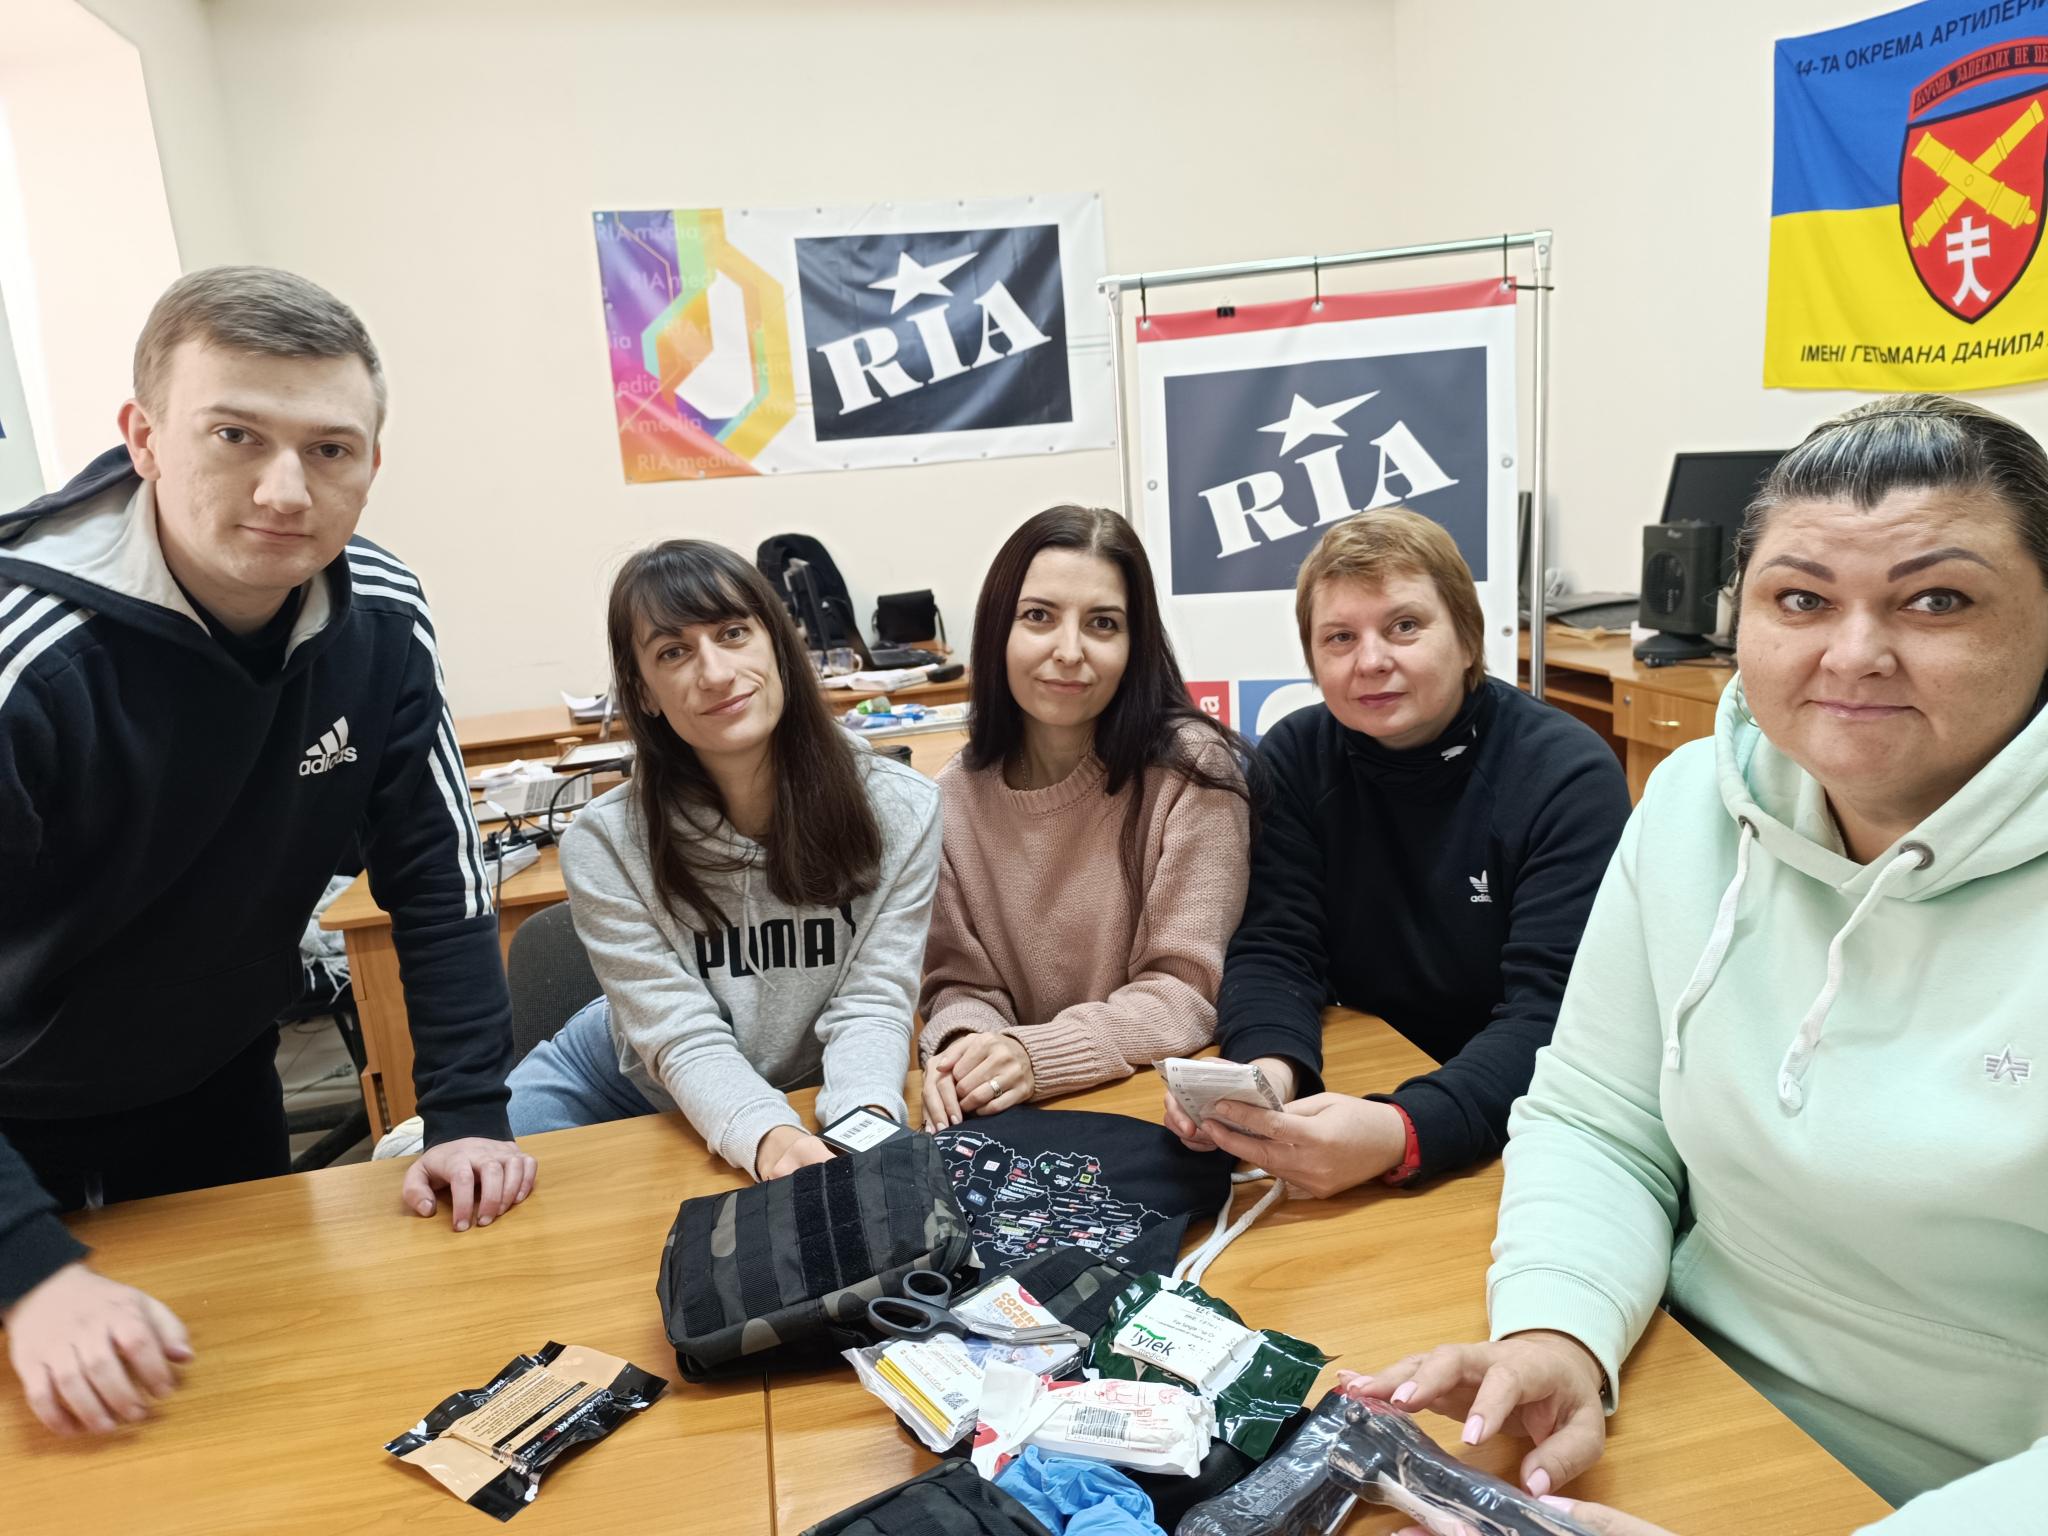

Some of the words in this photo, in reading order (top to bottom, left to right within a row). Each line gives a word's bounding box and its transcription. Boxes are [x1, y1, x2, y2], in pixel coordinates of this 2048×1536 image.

[1845, 31, 1924, 69] ОКРЕМА
[816, 280, 1052, 415] RIA
[1800, 344, 1847, 363] ІМЕНІ
[1851, 344, 1946, 365] ГЕТЬМАНА
[1951, 330, 2045, 365] ДАНИЛА
[637, 454, 674, 471] RIA
[1198, 420, 1460, 559] RIA
[693, 918, 836, 979] PUMA
